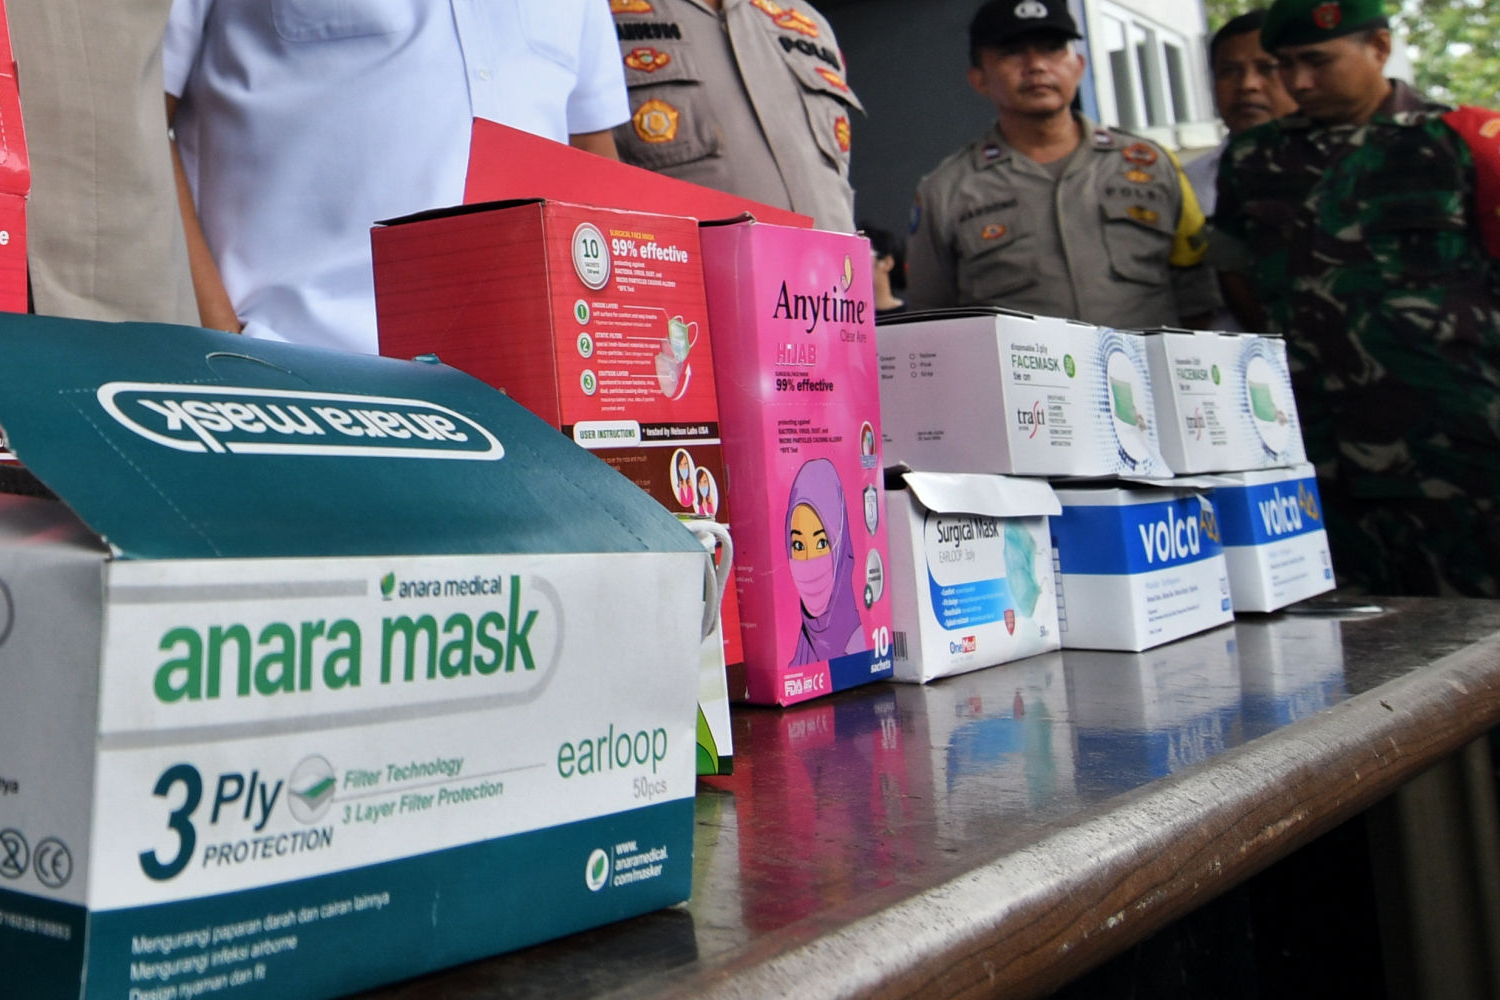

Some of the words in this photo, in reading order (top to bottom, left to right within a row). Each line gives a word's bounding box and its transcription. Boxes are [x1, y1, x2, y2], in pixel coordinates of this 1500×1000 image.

[582, 238, 599, 259] 10
[611, 239, 638, 258] 99%
[640, 242, 688, 263] effective
[772, 279, 866, 334] Anytime
[582, 338, 589, 352] 2
[840, 329, 856, 343] Clear
[1011, 354, 1061, 372] FACEMASK
[1013, 372, 1022, 381] tie
[1023, 373, 1031, 381] on
[584, 375, 592, 389] 3
[776, 378, 796, 392] 99%
[797, 379, 834, 392] effective
[137, 399, 326, 453] mask
[311, 406, 468, 443] anara
[579, 430, 596, 439] USER
[597, 428, 636, 439] INSTRUCTIONS
[1258, 486, 1303, 537] volca
[937, 518, 974, 548] Surgical
[975, 516, 999, 539] Mask
[1139, 506, 1200, 564] volca
[399, 577, 442, 598] anara
[444, 574, 502, 597] medical
[153, 613, 362, 704] anara
[379, 575, 540, 684] mask
[872, 625, 889, 659] 10
[870, 659, 891, 674] sachets
[557, 723, 668, 779] earloop
[343, 769, 382, 790] Filter
[386, 757, 464, 783] Technology
[632, 777, 668, 802] 50pcs
[342, 804, 352, 825] 3
[355, 800, 397, 824] Layer
[399, 793, 435, 814] Filter
[438, 779, 504, 806] Protection
[139, 761, 202, 883] 3
[211, 769, 282, 832] Ply
[202, 826, 334, 869] PROTECTION
[614, 844, 669, 872] anaramedical.
[615, 840, 638, 856] www.
[613, 863, 663, 887] com/masker
[131, 925, 212, 956] Mengurangi
[212, 917, 262, 945] paparan
[263, 910, 297, 932] darah
[298, 906, 320, 924] dan
[320, 899, 353, 919] cairan
[353, 890, 391, 911] lainnya
[130, 952, 210, 982] Mengurangi
[211, 946, 250, 967] infeksi
[250, 934, 298, 959] airborne
[128, 983, 178, 1000] Design
[178, 972, 228, 1000] nyaman
[229, 968, 253, 987] dan
[254, 962, 267, 981] fit
